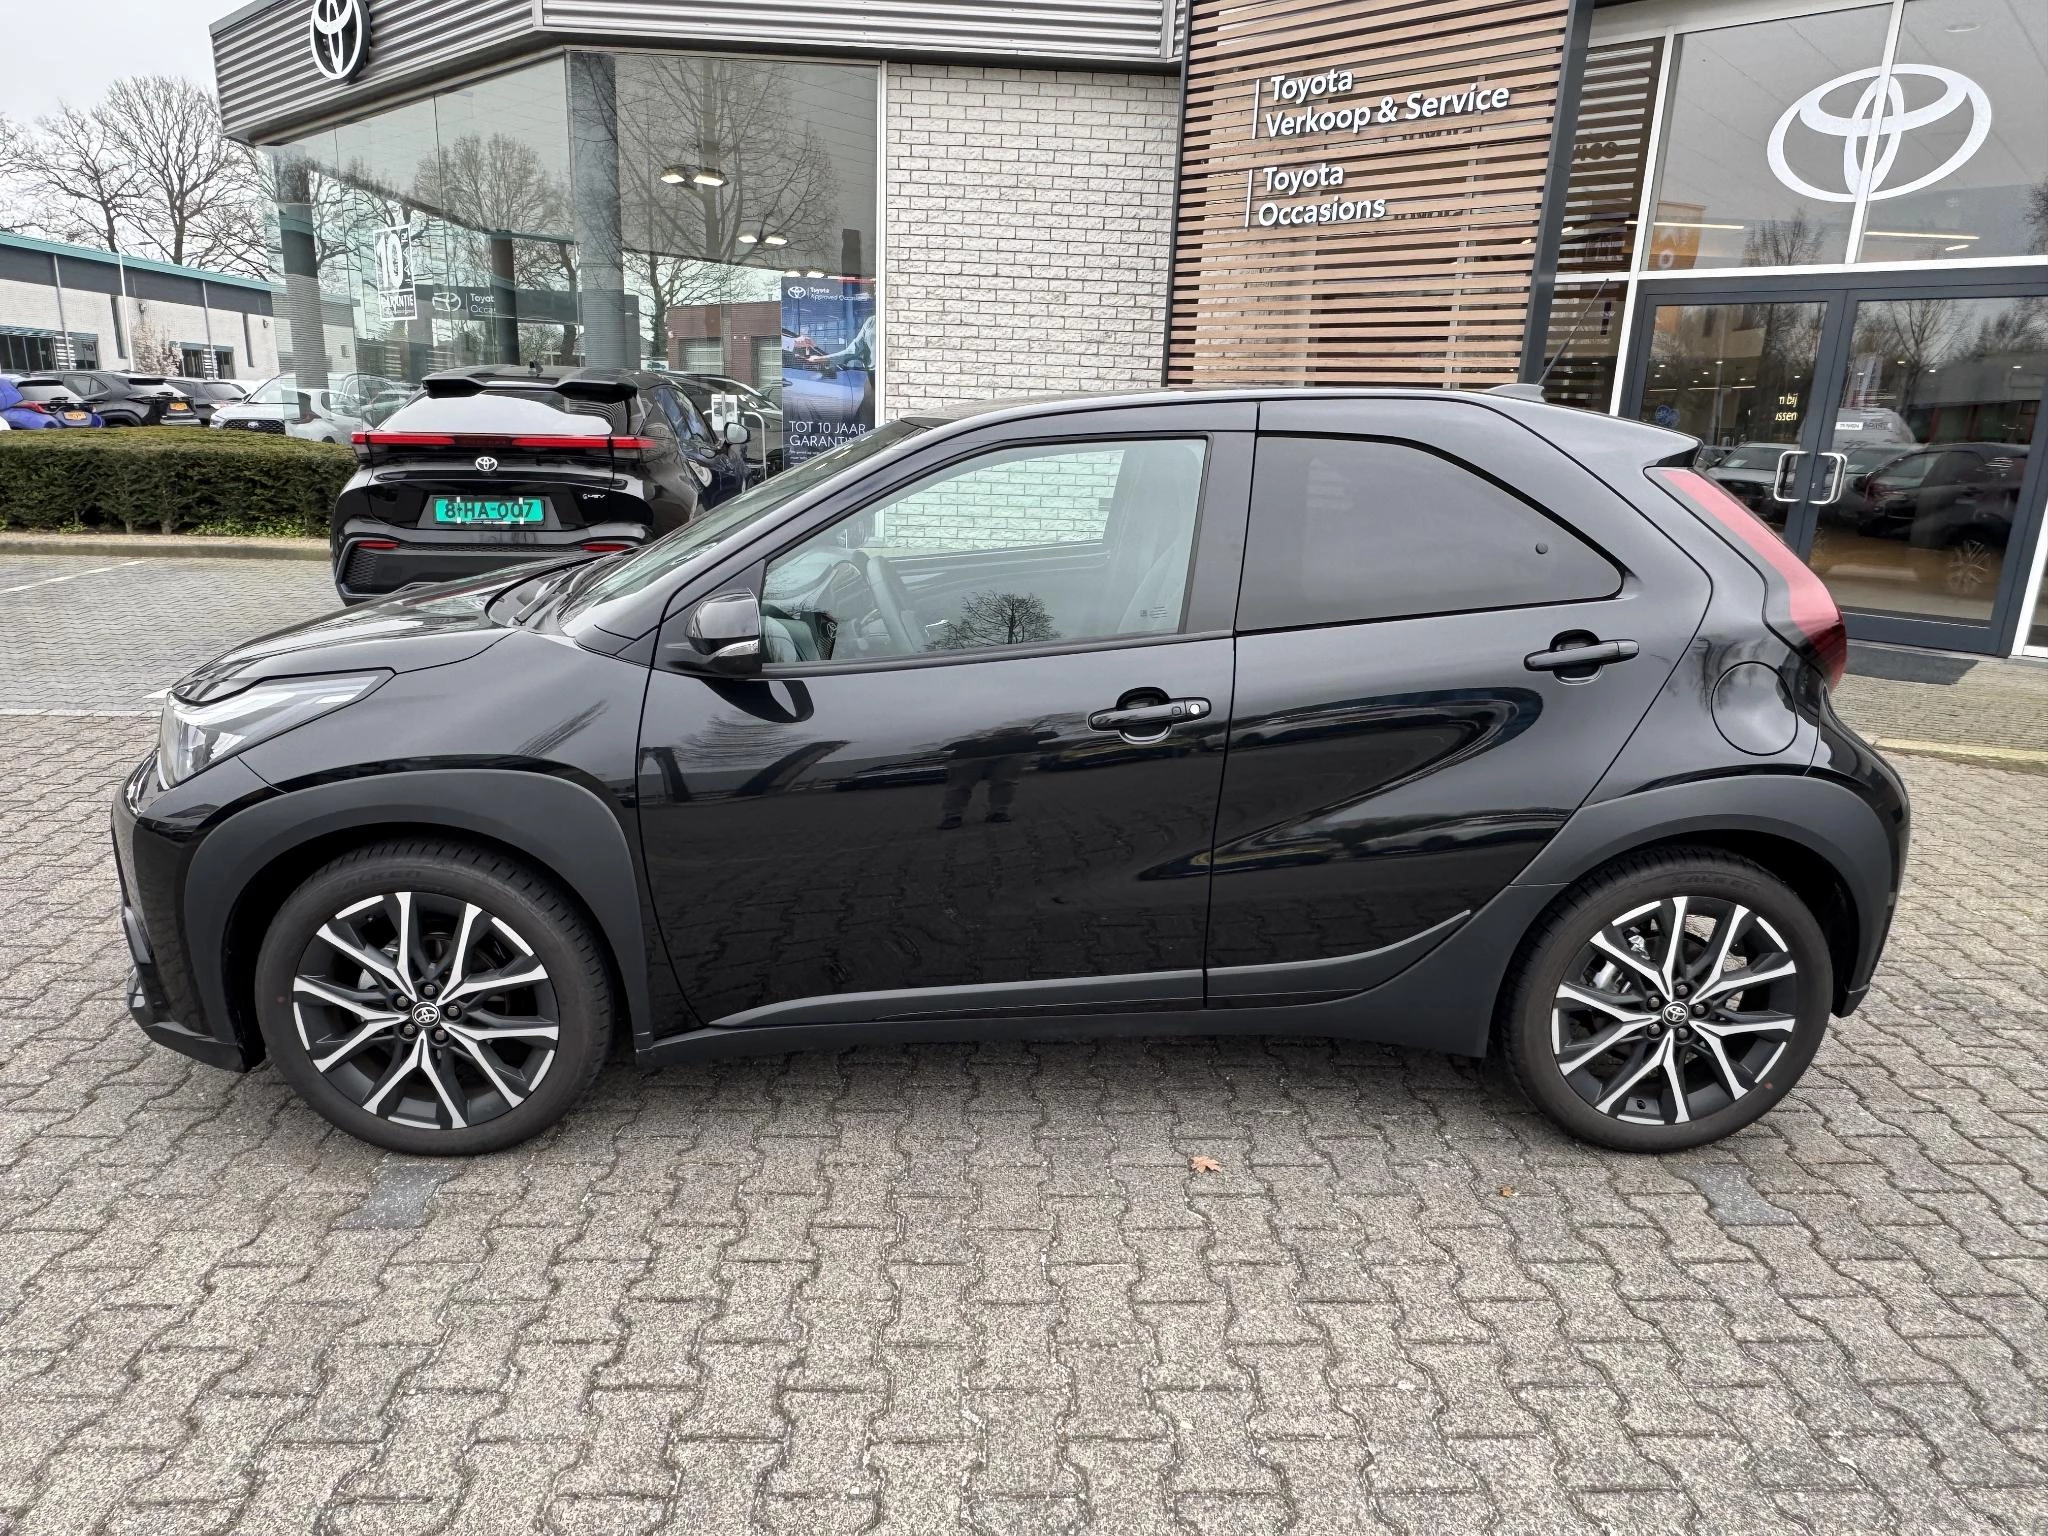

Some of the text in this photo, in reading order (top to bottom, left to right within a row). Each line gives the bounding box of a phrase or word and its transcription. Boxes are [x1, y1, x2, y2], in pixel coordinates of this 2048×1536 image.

[1271, 68, 1353, 104] Toyota
[1265, 106, 1371, 137] Verkoop
[1377, 95, 1398, 123] &
[1405, 83, 1510, 120] Service
[1263, 163, 1345, 196] Toyota
[1258, 195, 1387, 227] Occasions
[789, 421, 866, 435] TOT 10 JAAR
